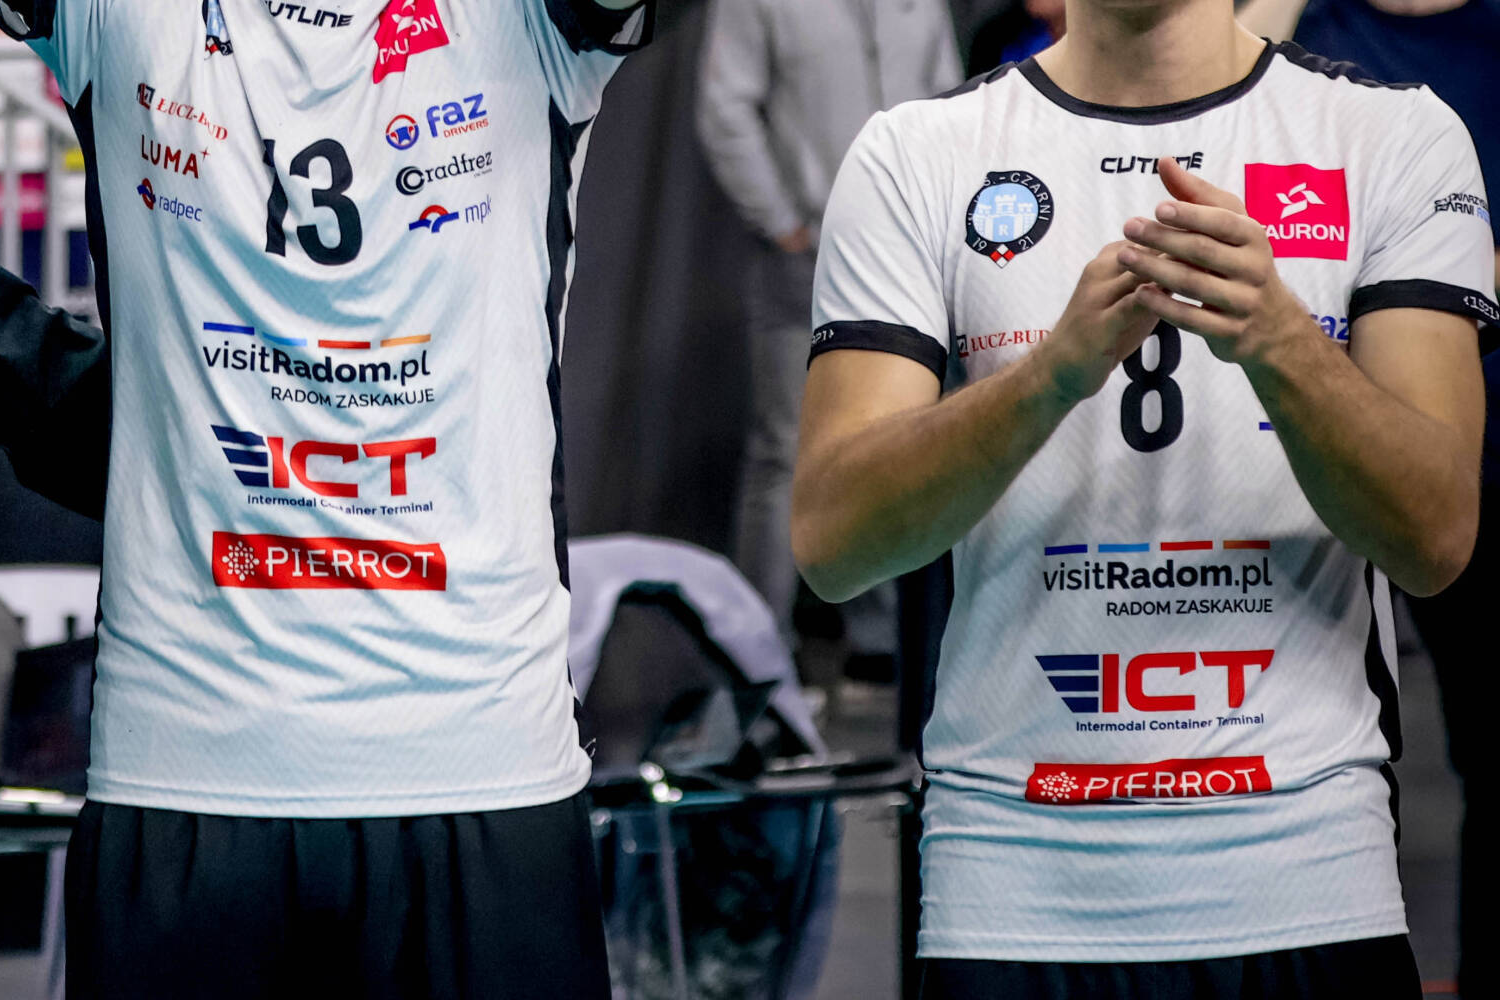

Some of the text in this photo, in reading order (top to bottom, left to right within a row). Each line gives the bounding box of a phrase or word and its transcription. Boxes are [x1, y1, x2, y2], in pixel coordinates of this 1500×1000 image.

[263, 0, 354, 28] UTLINE
[426, 93, 487, 138] faz
[443, 119, 489, 138] DRIVERS
[425, 151, 493, 182] radfrez
[159, 195, 203, 222] radpec
[262, 138, 363, 266] 13
[972, 237, 987, 251] 19
[1018, 235, 1035, 250] 21
[1261, 223, 1345, 242] AURON
[202, 340, 431, 386] visitRadom.pl
[271, 386, 435, 409] RADOM ZASKAKUJE
[1120, 319, 1184, 453] 8
[267, 436, 437, 498] ICT
[247, 494, 317, 508] Intermodal
[380, 501, 433, 516] Terminal
[265, 546, 435, 579] PIERROT
[1043, 557, 1272, 592] visitRadom.pl
[1106, 598, 1273, 617] RADOM ZASKAKUJE
[1102, 649, 1275, 713] ICT
[1076, 713, 1264, 732] Intermodal Container Terminal
[1084, 767, 1257, 800] PIERROT
